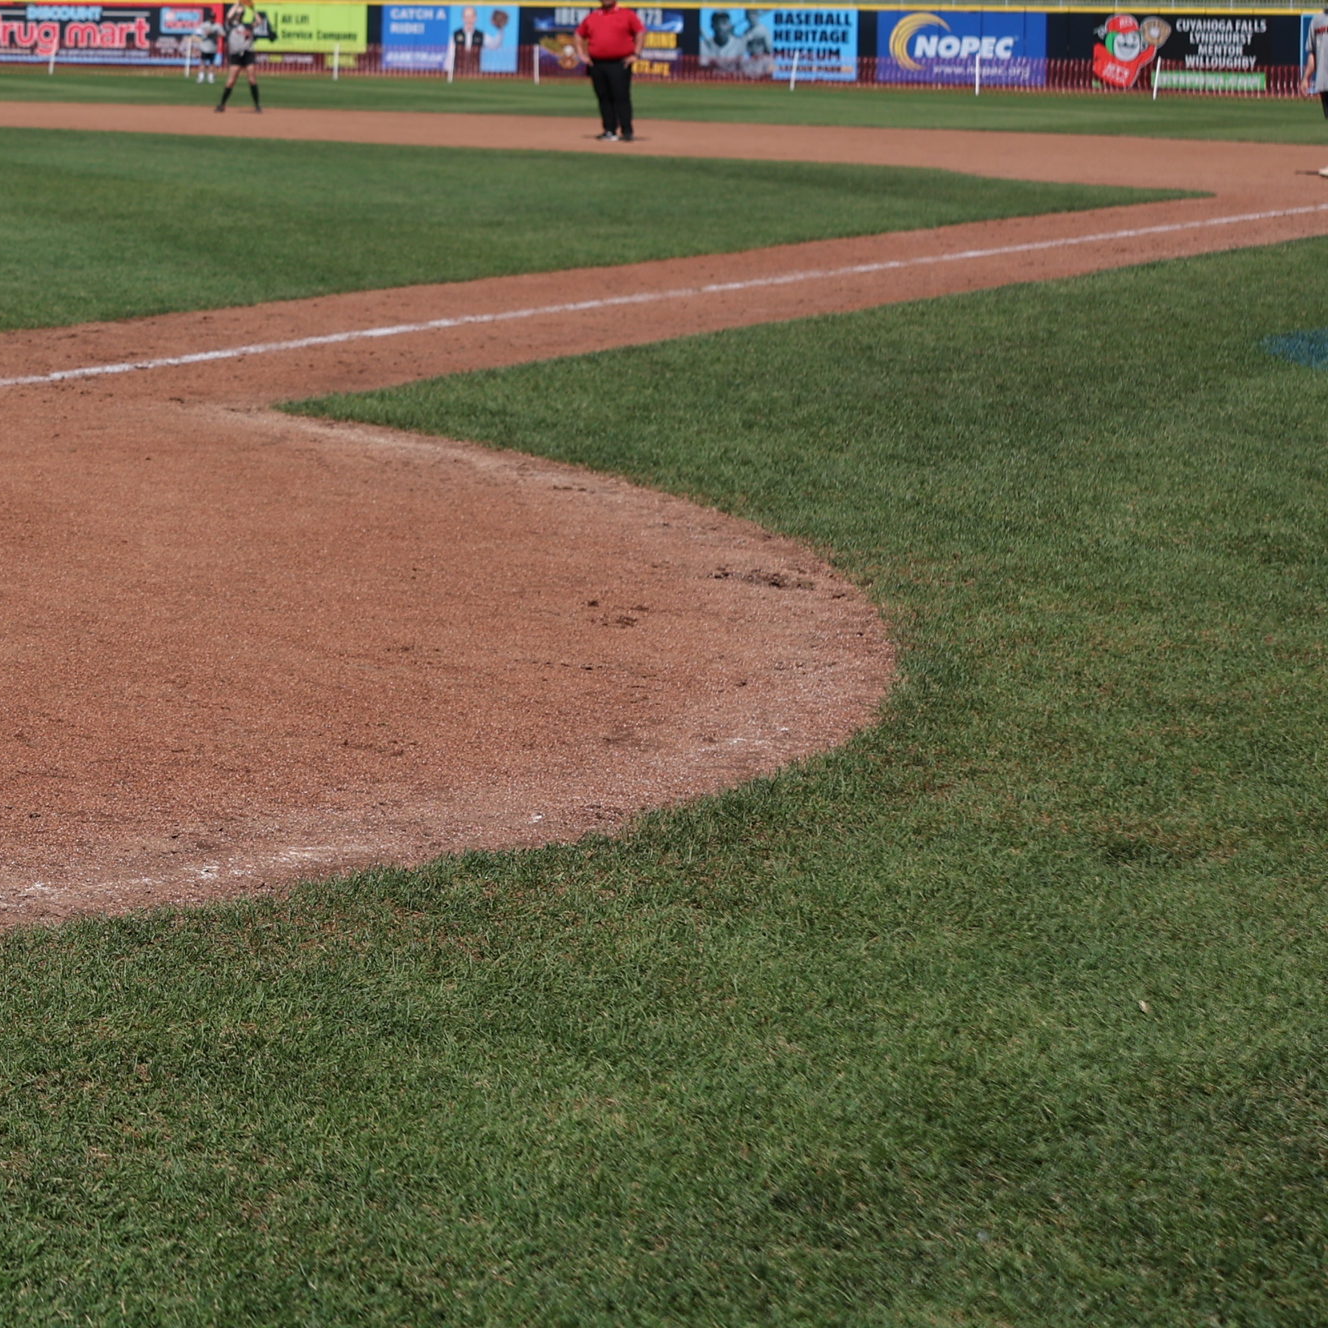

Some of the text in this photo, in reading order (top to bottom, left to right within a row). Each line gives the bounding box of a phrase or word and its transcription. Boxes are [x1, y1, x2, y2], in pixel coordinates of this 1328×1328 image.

[26, 5, 103, 21] DISCOUNT
[282, 14, 310, 24] All Lift
[390, 8, 447, 20] CATCH A
[774, 13, 851, 26] BASEBALL
[390, 22, 426, 34] RIDE!
[1175, 18, 1267, 33] CUYAHOGA FALLS
[65, 17, 150, 49] mart
[282, 31, 357, 42] Service Company
[774, 30, 849, 43] HERITAGE
[1190, 32, 1253, 45] LYNDHURST
[774, 48, 841, 60] MUSEUM
[914, 35, 1014, 60] NOPEC
[1197, 45, 1243, 56] MENTOR
[1185, 55, 1257, 69] WILLOUGHBY
